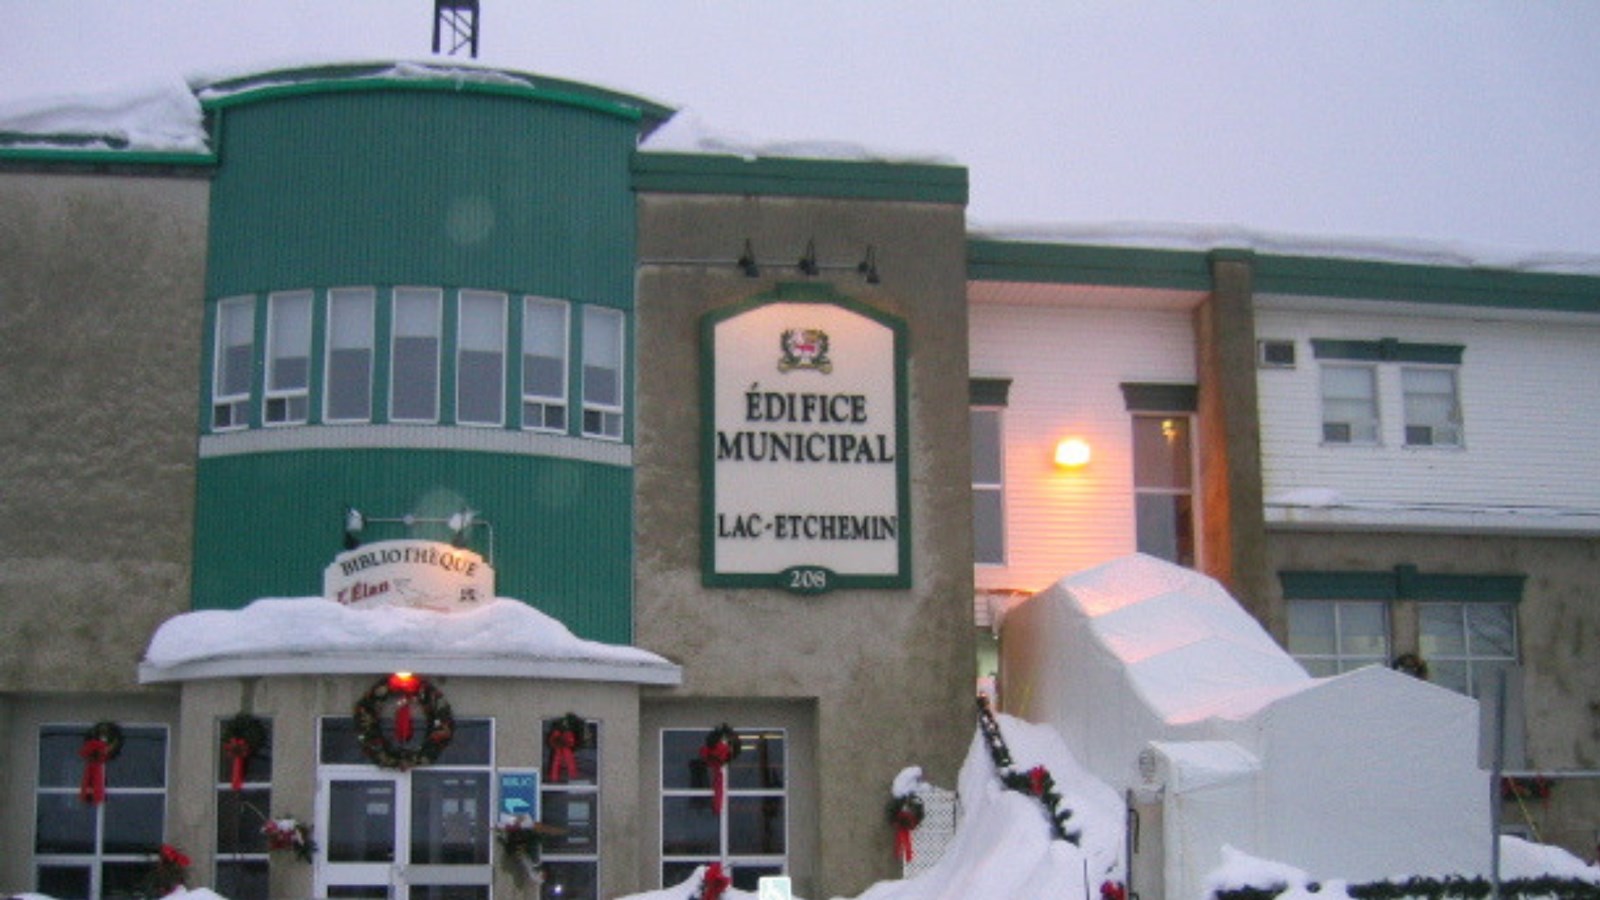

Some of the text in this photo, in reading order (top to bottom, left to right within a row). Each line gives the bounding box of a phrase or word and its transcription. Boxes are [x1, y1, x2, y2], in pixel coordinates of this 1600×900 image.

[745, 382, 867, 422] ÉDIFICE
[717, 431, 894, 463] MUNICIPAL
[718, 513, 896, 540] LAC-ETCHEMIN
[340, 547, 478, 576] BIBLIOTHÈQUE
[789, 570, 826, 587] 208
